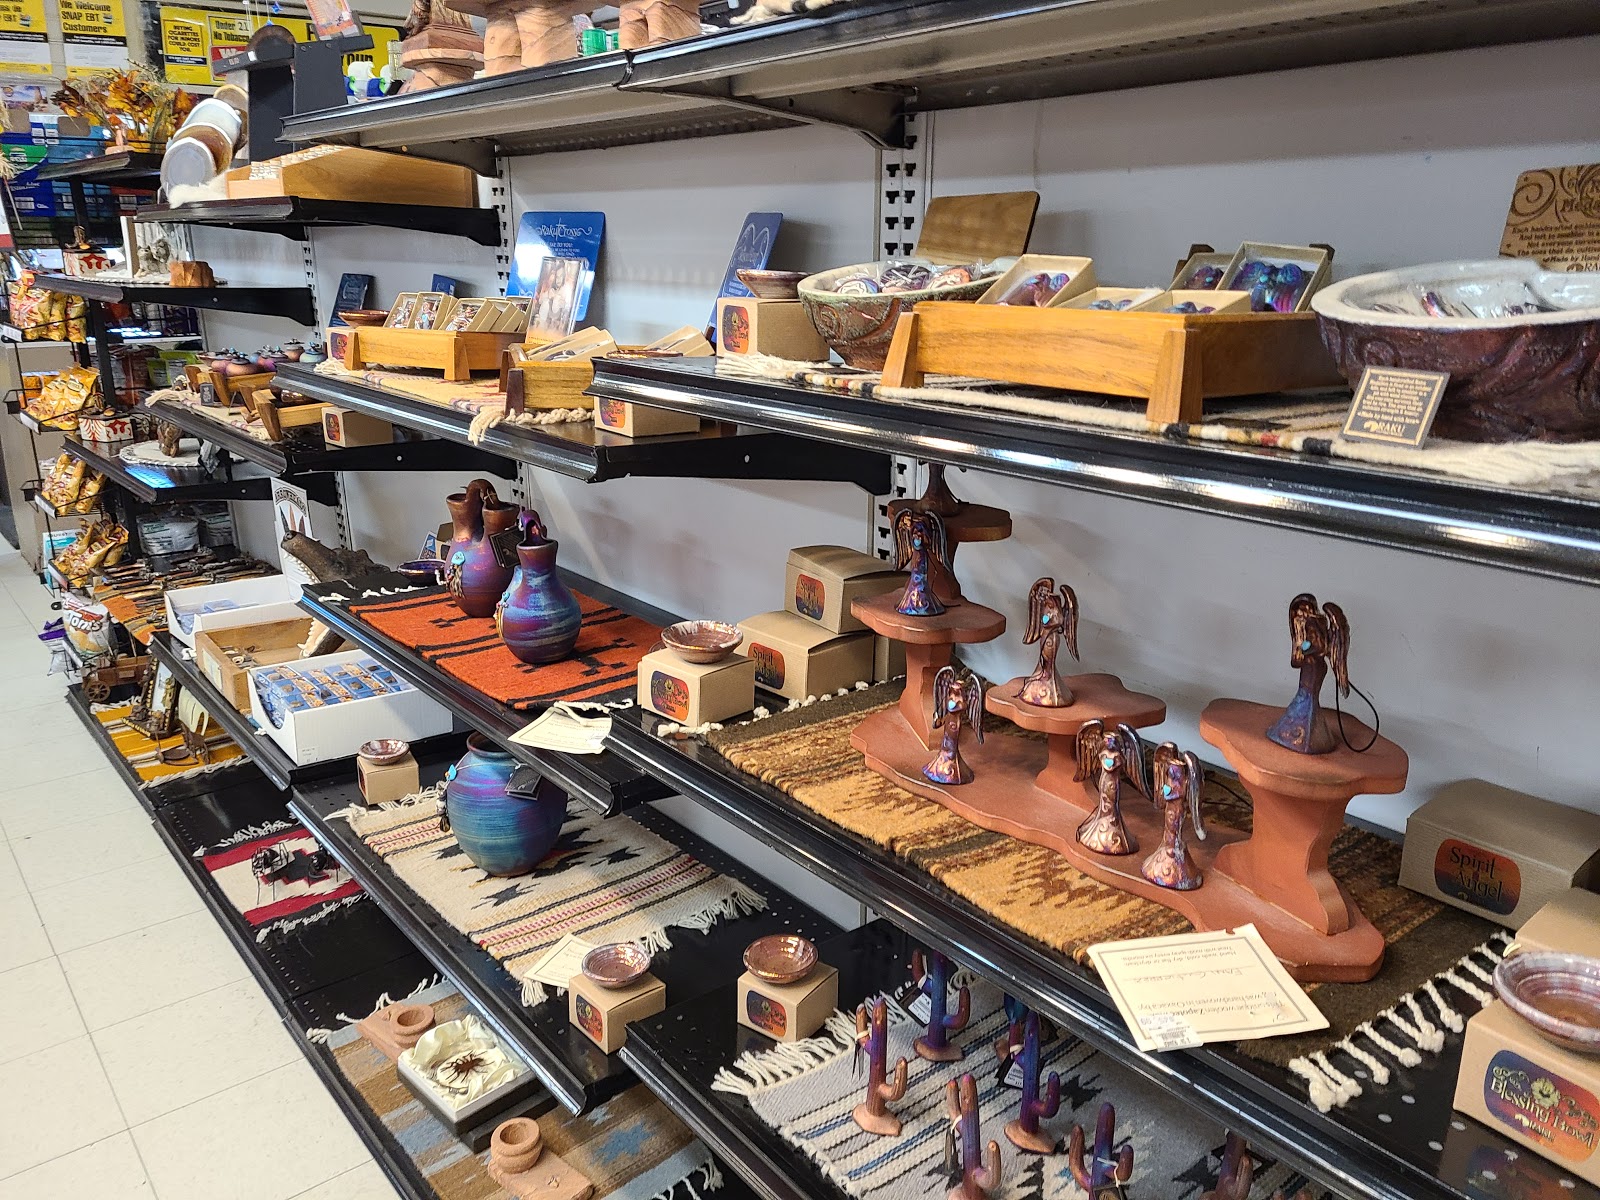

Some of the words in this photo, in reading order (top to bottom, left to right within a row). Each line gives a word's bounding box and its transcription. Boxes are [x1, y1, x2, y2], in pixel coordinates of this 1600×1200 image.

[75, 1, 111, 12] Welcome
[61, 11, 82, 20] SNAP
[86, 13, 99, 22] EBT
[63, 22, 107, 33] Customers
[215, 20, 236, 31] Under
[238, 22, 249, 31] 21
[214, 31, 222, 41] No
[753, 647, 773, 666] Spirit
[1450, 846, 1496, 880] Spirit
[1456, 870, 1503, 902] Angel
[1491, 1078, 1551, 1124] Blessing
[1552, 1116, 1595, 1151] Bowl
